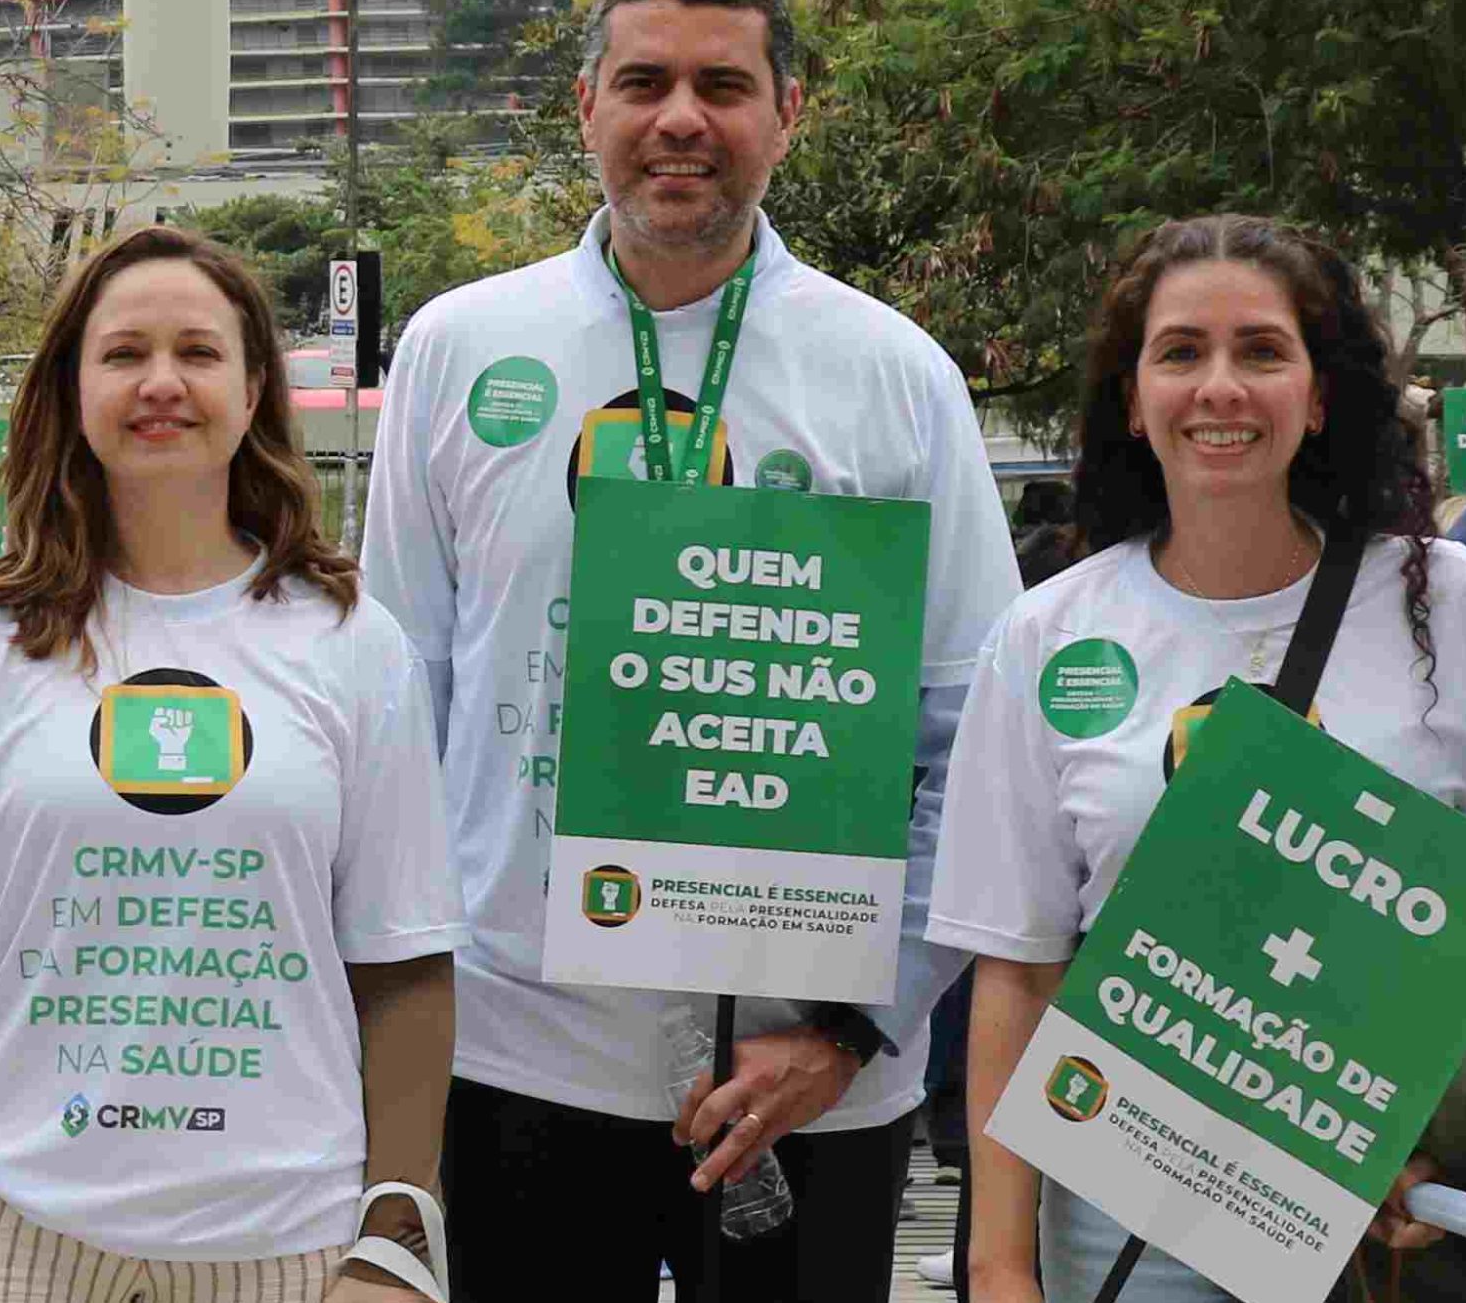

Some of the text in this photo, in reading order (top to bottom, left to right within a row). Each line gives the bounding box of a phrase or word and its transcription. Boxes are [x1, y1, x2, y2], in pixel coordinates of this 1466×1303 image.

[677, 544, 823, 591] QUEM
[632, 597, 861, 649] DEFENDE
[609, 652, 876, 706] O SUS NÃO
[649, 712, 829, 758] ACEITA
[684, 770, 790, 810] EAD
[74, 846, 265, 880] CRMV-SP
[1237, 788, 1449, 938] LUCRO
[52, 896, 277, 931] EM DEFESA
[651, 898, 705, 910] DEFESA
[749, 905, 879, 923] PRESENCIALIDADE
[652, 879, 879, 907] PRESENCIAL É ESSENCIAL
[697, 915, 778, 929] FORMAÇÃO
[782, 920, 802, 931] EM
[20, 942, 309, 988] DA FORMAÇÃO
[29, 995, 282, 1030] PRESENCIAL
[1124, 928, 1398, 1113] FORMAÇÃO DE
[57, 1037, 263, 1078] NA SAÚDE
[1096, 974, 1377, 1166] QUALIDADE
[97, 1104, 190, 1129] CRMV
[1109, 1113, 1324, 1252] DEFESA PRESENCIALIDADE
[1117, 1097, 1331, 1237] PRESENCIAL É ESSENCIAL
[1144, 1152, 1223, 1204] FORMAÇÃO
[1226, 1201, 1247, 1219] EM
